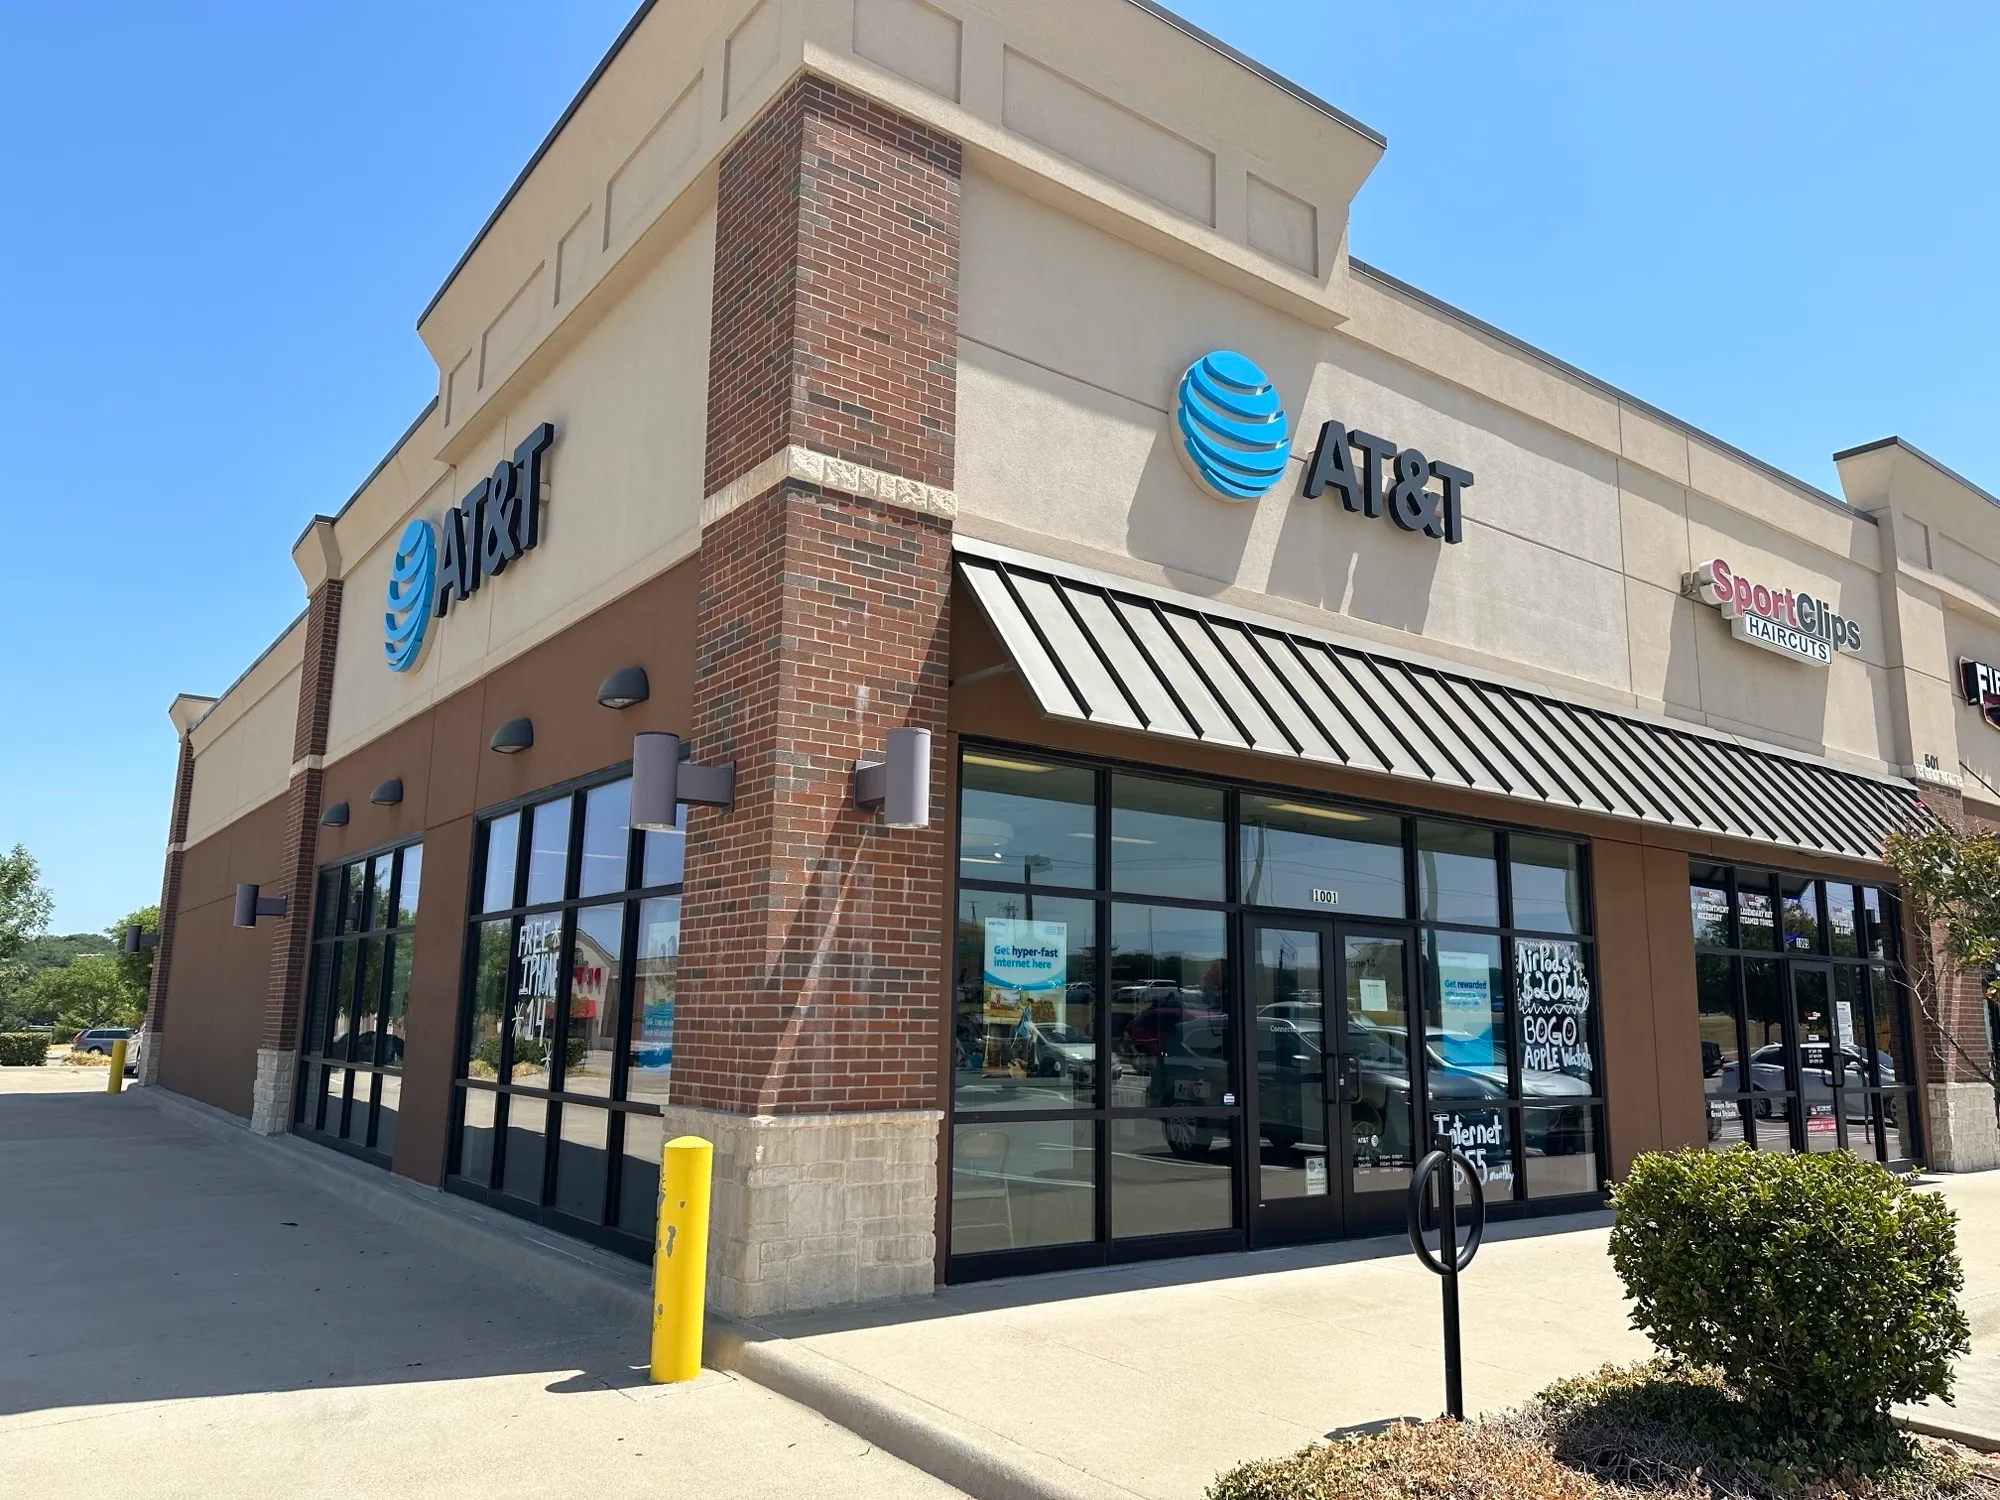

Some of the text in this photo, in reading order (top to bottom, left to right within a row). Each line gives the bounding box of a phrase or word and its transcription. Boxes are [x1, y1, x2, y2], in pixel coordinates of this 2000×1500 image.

[1303, 420, 1474, 544] AT&T
[433, 422, 554, 618] AT&T
[1749, 615, 1828, 661] HAIRCUTS
[1924, 753, 1939, 771] 501
[1314, 890, 1337, 904] 1001
[517, 920, 549, 958] FREE
[994, 945, 1059, 958] Get hyper-fast
[994, 957, 1052, 969] internet here
[1518, 944, 1571, 975] AirPods
[1444, 979, 1487, 989] Get rewarded
[1522, 970, 1562, 1006] $20
[525, 998, 547, 1047] 14
[1523, 1015, 1577, 1046] BOGO
[1524, 1041, 1593, 1071] APPLE Watch
[1357, 1136, 1369, 1144] AT&T
[1433, 1113, 1502, 1147] Internet
